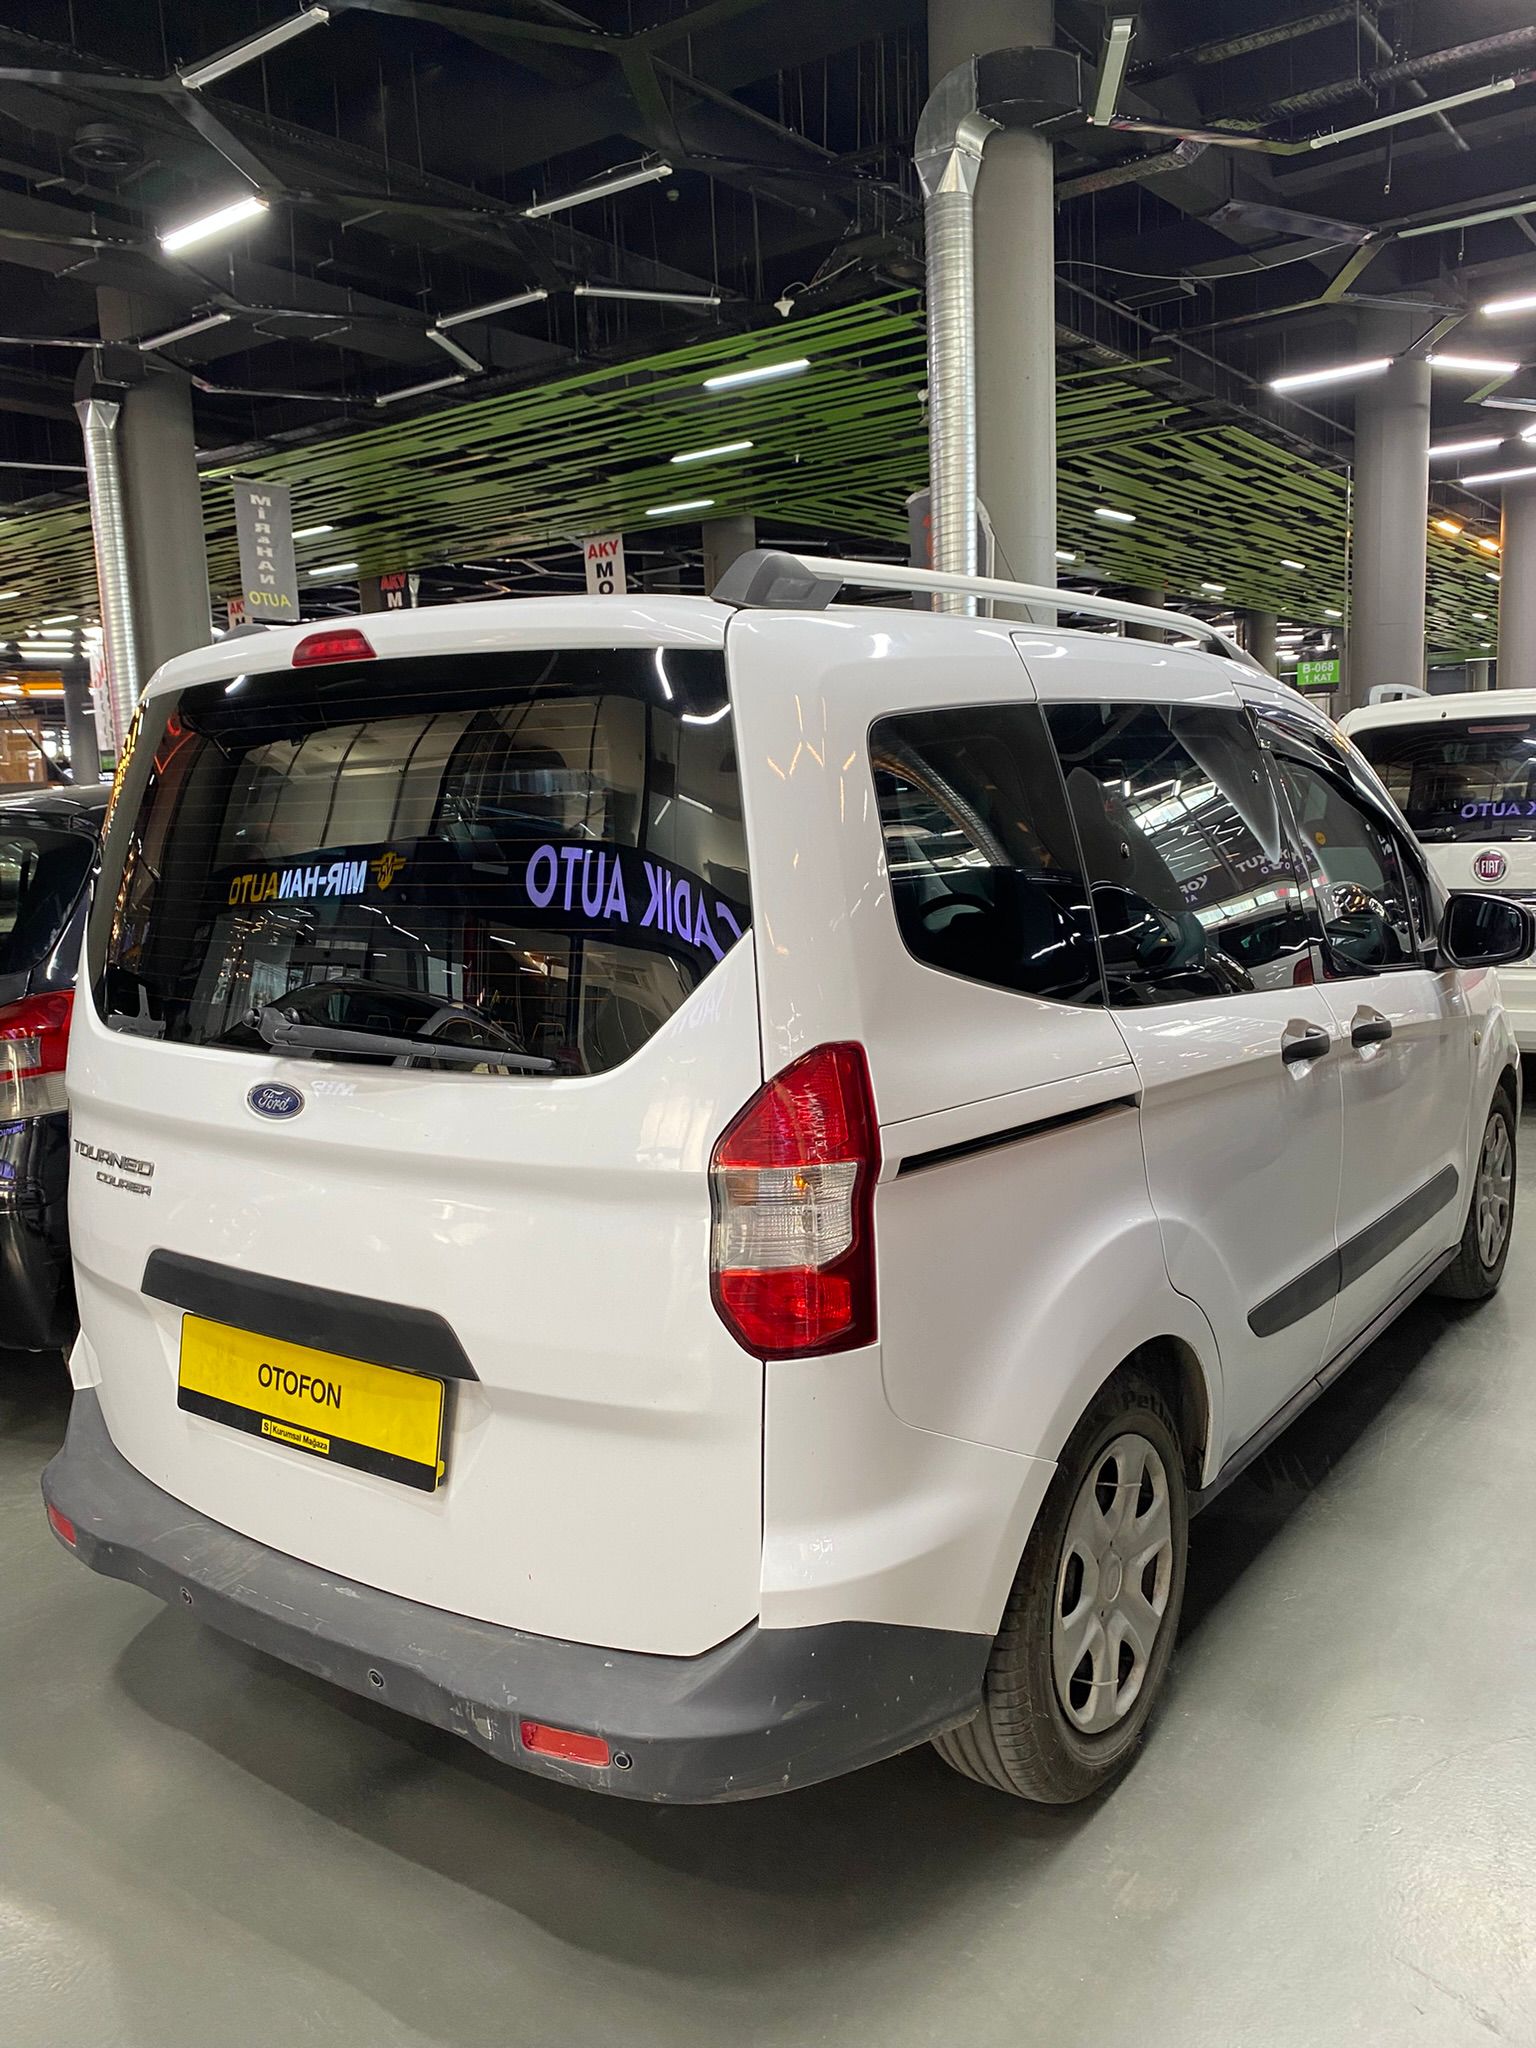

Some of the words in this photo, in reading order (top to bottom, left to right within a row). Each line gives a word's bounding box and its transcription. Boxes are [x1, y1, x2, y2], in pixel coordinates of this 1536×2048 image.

[587, 540, 619, 560] AKY
[1302, 661, 1335, 674] B-068
[1313, 672, 1333, 683] KAT
[1481, 860, 1500, 874] FIAT
[258, 1088, 292, 1112] Ford
[73, 1138, 155, 1178] TOURNEO
[96, 1170, 152, 1197] COURIER
[257, 1363, 342, 1409] OTOFON
[263, 1422, 270, 1432] S
[272, 1425, 302, 1442] Kurumsal
[302, 1434, 328, 1450] Mağaza
